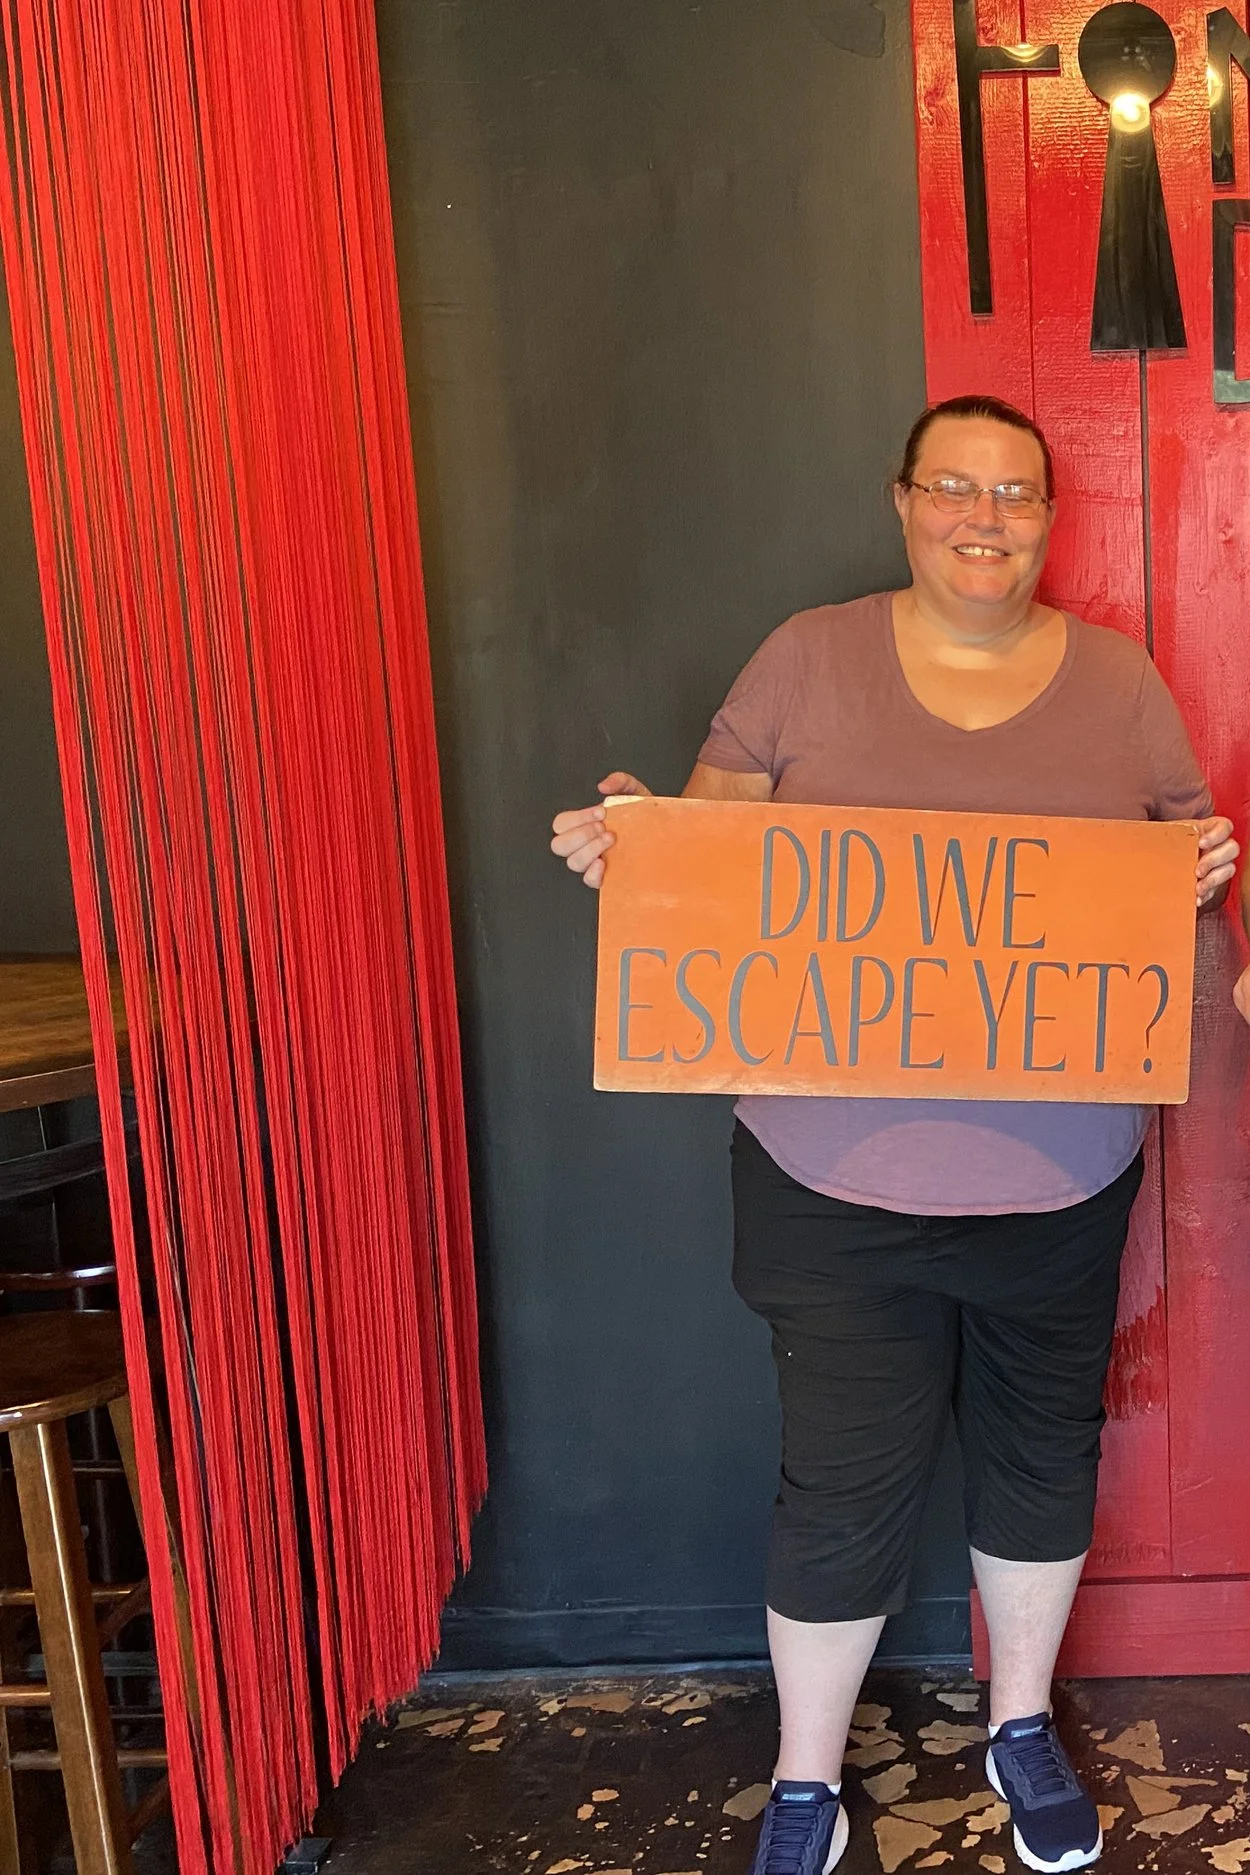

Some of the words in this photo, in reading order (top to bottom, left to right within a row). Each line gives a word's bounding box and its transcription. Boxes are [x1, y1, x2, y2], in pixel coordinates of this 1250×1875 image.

[761, 826, 885, 942] DID
[913, 833, 1049, 949] WE
[617, 948, 948, 1069] ESCAPE
[973, 960, 1169, 1074] YET?
